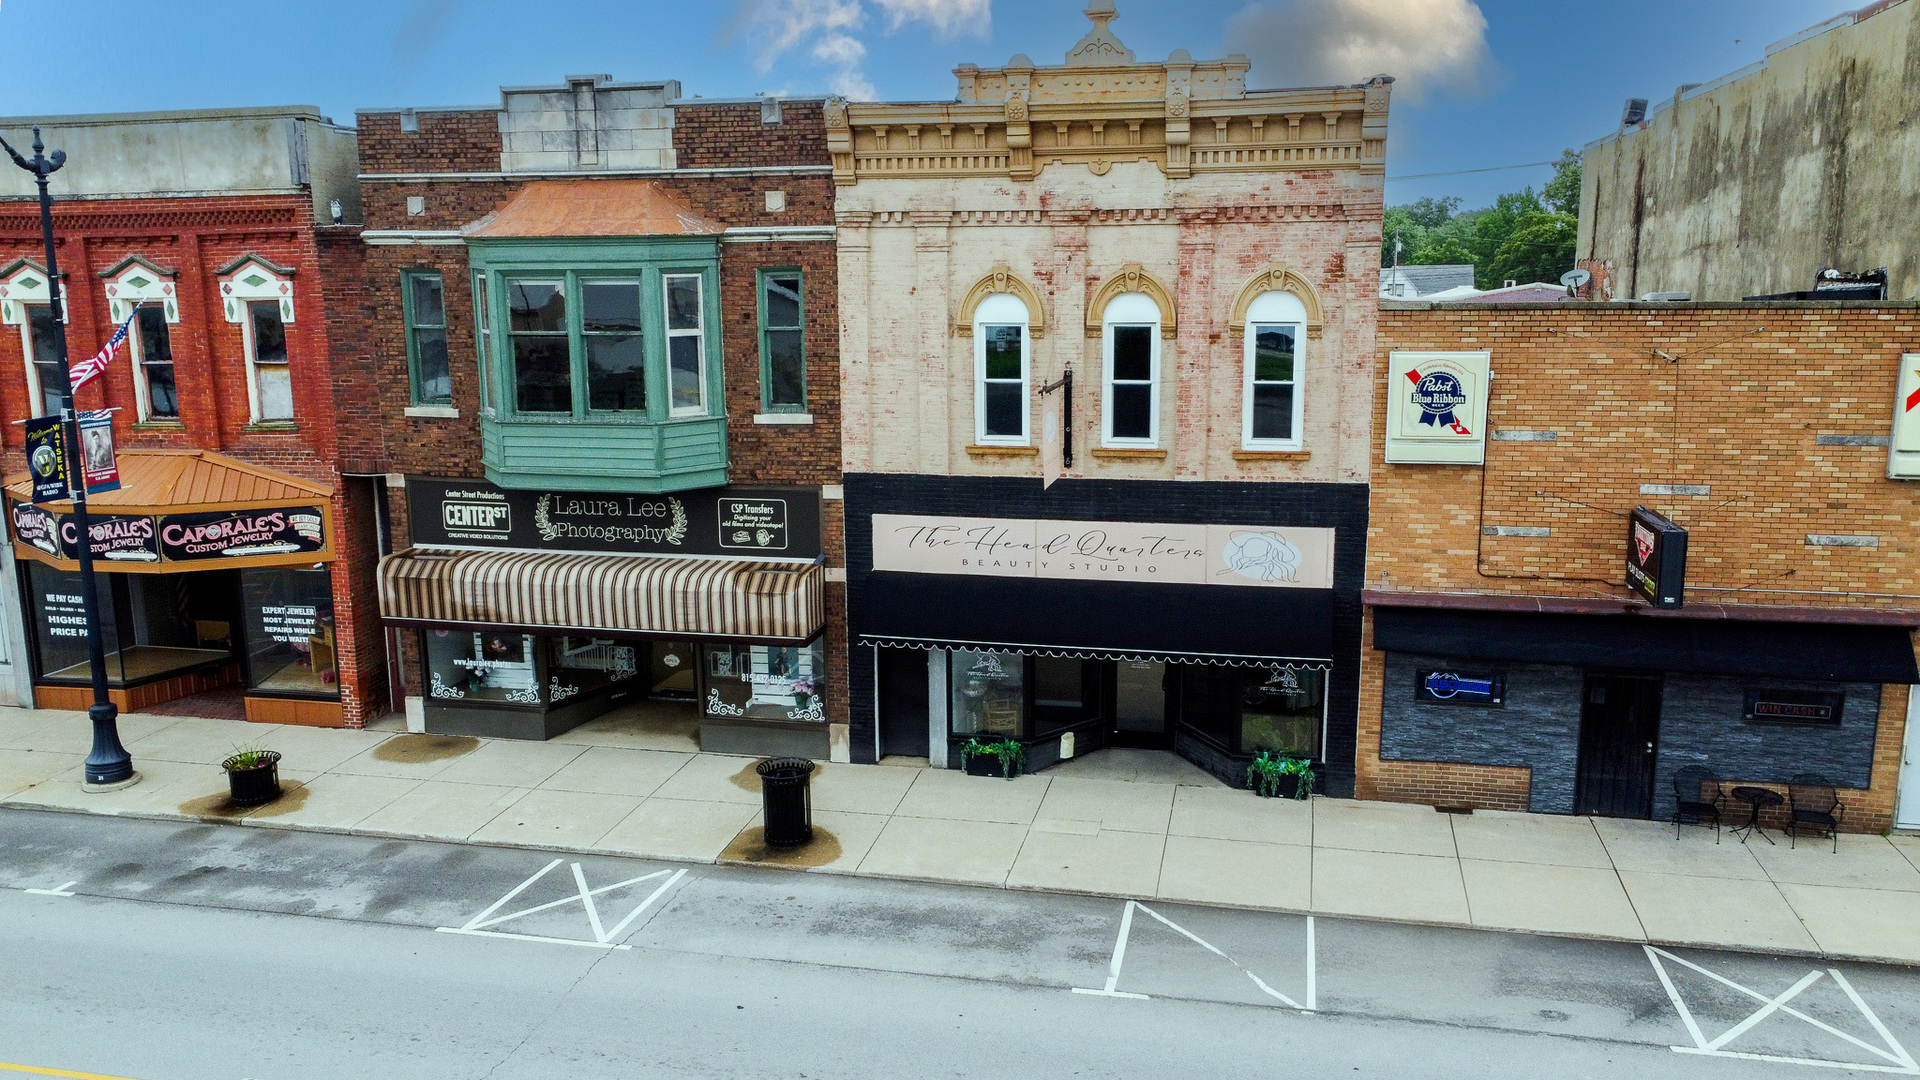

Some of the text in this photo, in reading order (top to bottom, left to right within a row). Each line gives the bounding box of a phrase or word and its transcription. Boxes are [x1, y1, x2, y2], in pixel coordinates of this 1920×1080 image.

[1423, 377, 1454, 392] Pabst
[1412, 393, 1465, 404] Blue Ribbon
[52, 423, 65, 480] WATSEKA
[445, 489, 505, 500] Center Street Productions
[554, 495, 666, 518] Laura Lee
[731, 503, 774, 514] CSP Transfers
[445, 504, 496, 527] CENTER
[733, 514, 759, 522] Digitizing
[62, 518, 153, 544] CORALE'S
[162, 512, 285, 546] CAPORALE'S
[756, 522, 784, 530] videotape!
[556, 522, 666, 544] Photography
[111, 538, 145, 549] JEWELRY
[185, 531, 274, 554] CUSTOM JEWELRY
[895, 525, 1205, 561] The Head Quarters
[962, 558, 1157, 573] BEAUTY STUDIO
[46, 594, 84, 604] WE PAY CASH
[262, 606, 315, 616] EXPERT JEWELER
[48, 615, 87, 625] HIGHES
[284, 617, 315, 625] JEWELRY
[50, 627, 77, 636] PRICE
[264, 626, 294, 634] REPAIRS
[1759, 704, 1816, 716] WIN CASH
